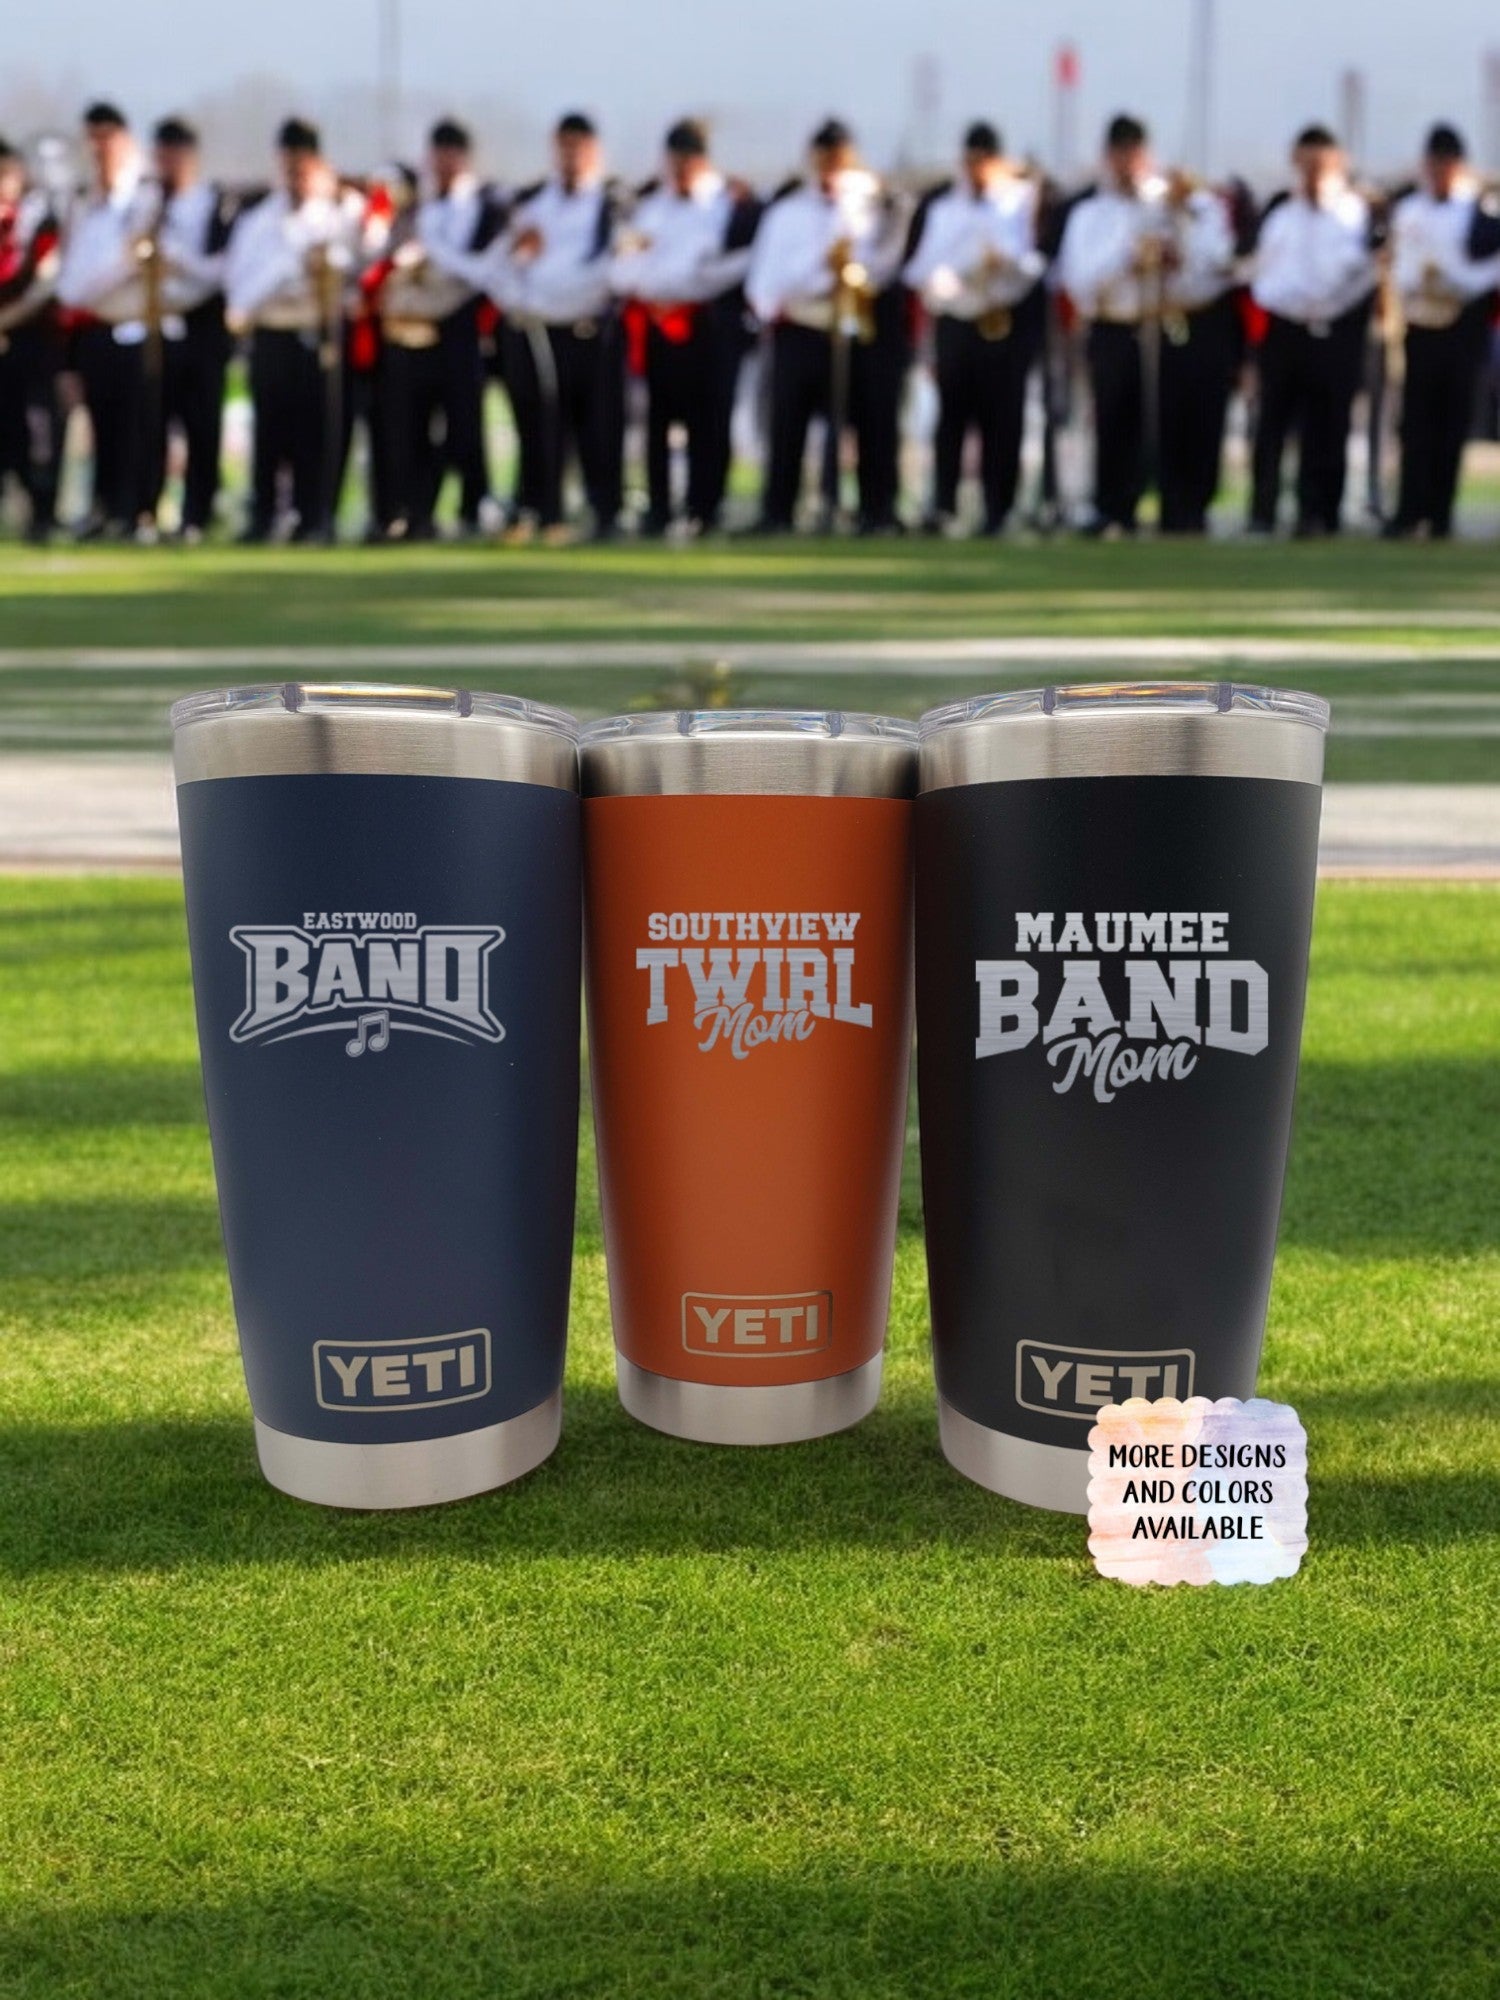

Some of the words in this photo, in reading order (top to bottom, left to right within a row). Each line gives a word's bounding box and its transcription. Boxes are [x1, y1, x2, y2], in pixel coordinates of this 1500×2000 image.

[303, 911, 417, 931] EASTWOOD
[648, 912, 861, 941] SOUTHVIEW
[1015, 912, 1229, 952] MAUMEE
[240, 934, 499, 1034] BAND
[636, 947, 873, 1029] TWIRL
[975, 960, 1269, 1060] BAND
[693, 1001, 816, 1061] Mom
[1046, 1032, 1199, 1103] Mom
[692, 1304, 819, 1345] YETI
[326, 1344, 476, 1397] YETI
[1030, 1354, 1179, 1407] YETI
